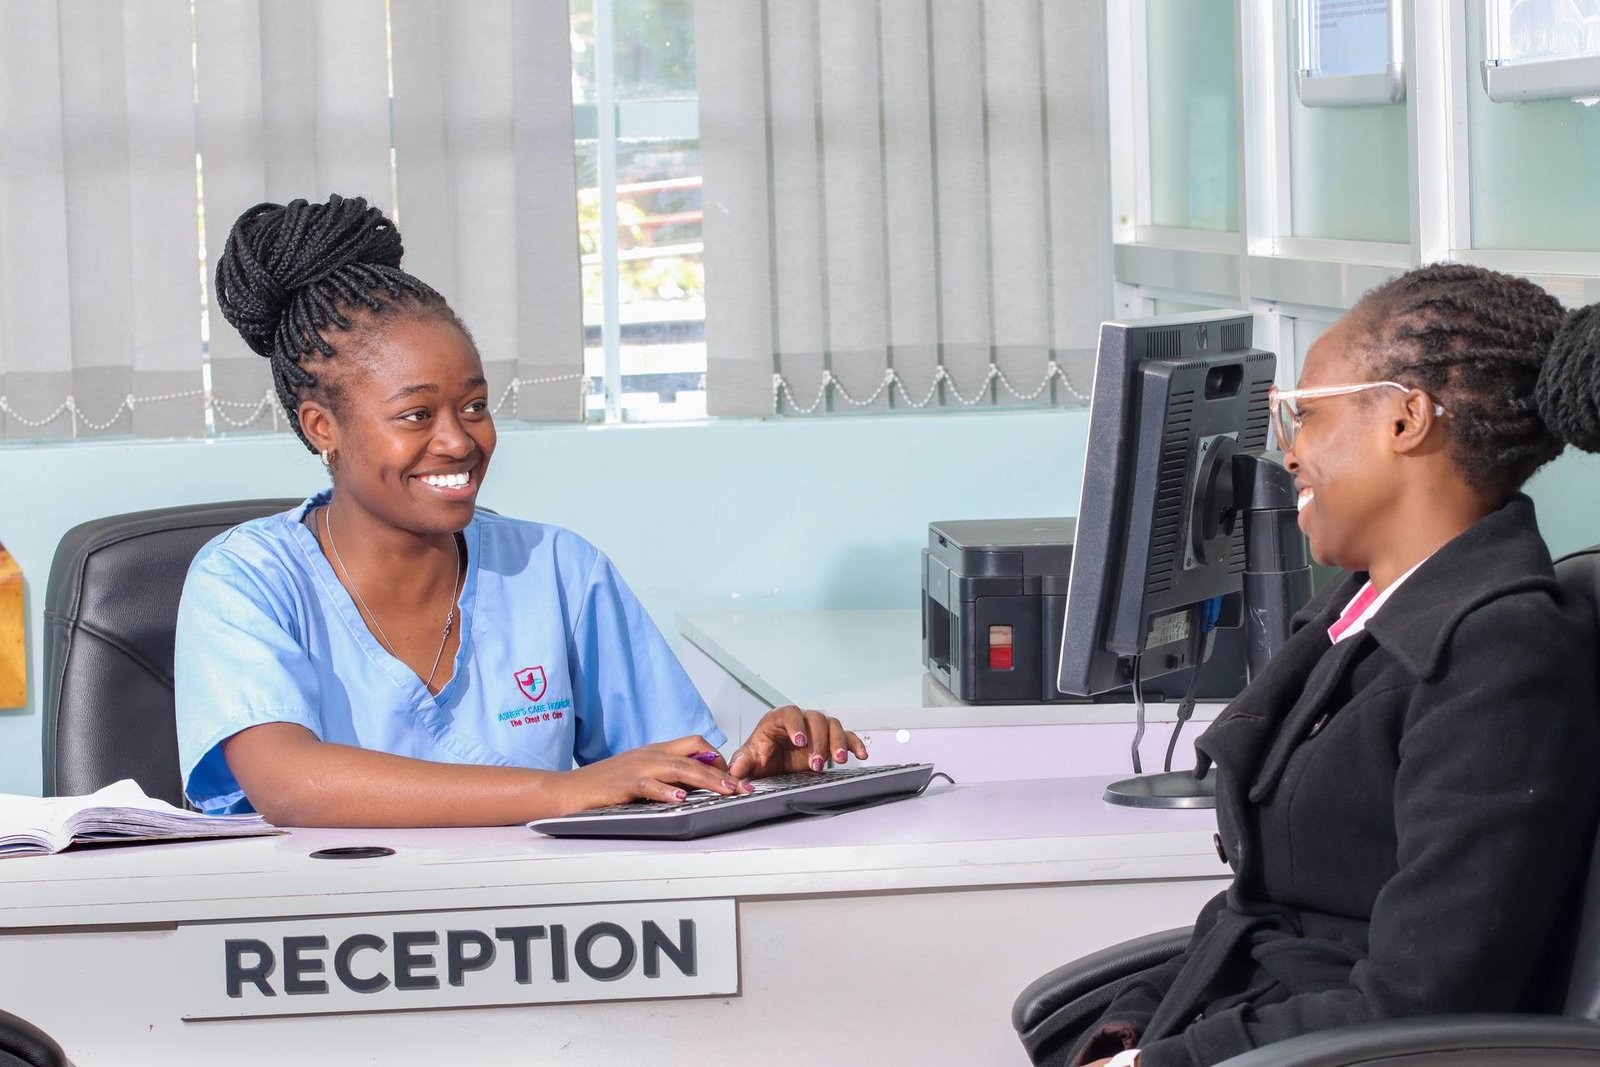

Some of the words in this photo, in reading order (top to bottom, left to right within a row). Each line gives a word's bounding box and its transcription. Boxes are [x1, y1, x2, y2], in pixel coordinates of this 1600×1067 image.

[528, 704, 546, 714] CARE
[510, 719, 523, 728] The
[525, 715, 541, 725] Crest
[543, 713, 551, 722] Of
[224, 919, 697, 997] RECEPTION
